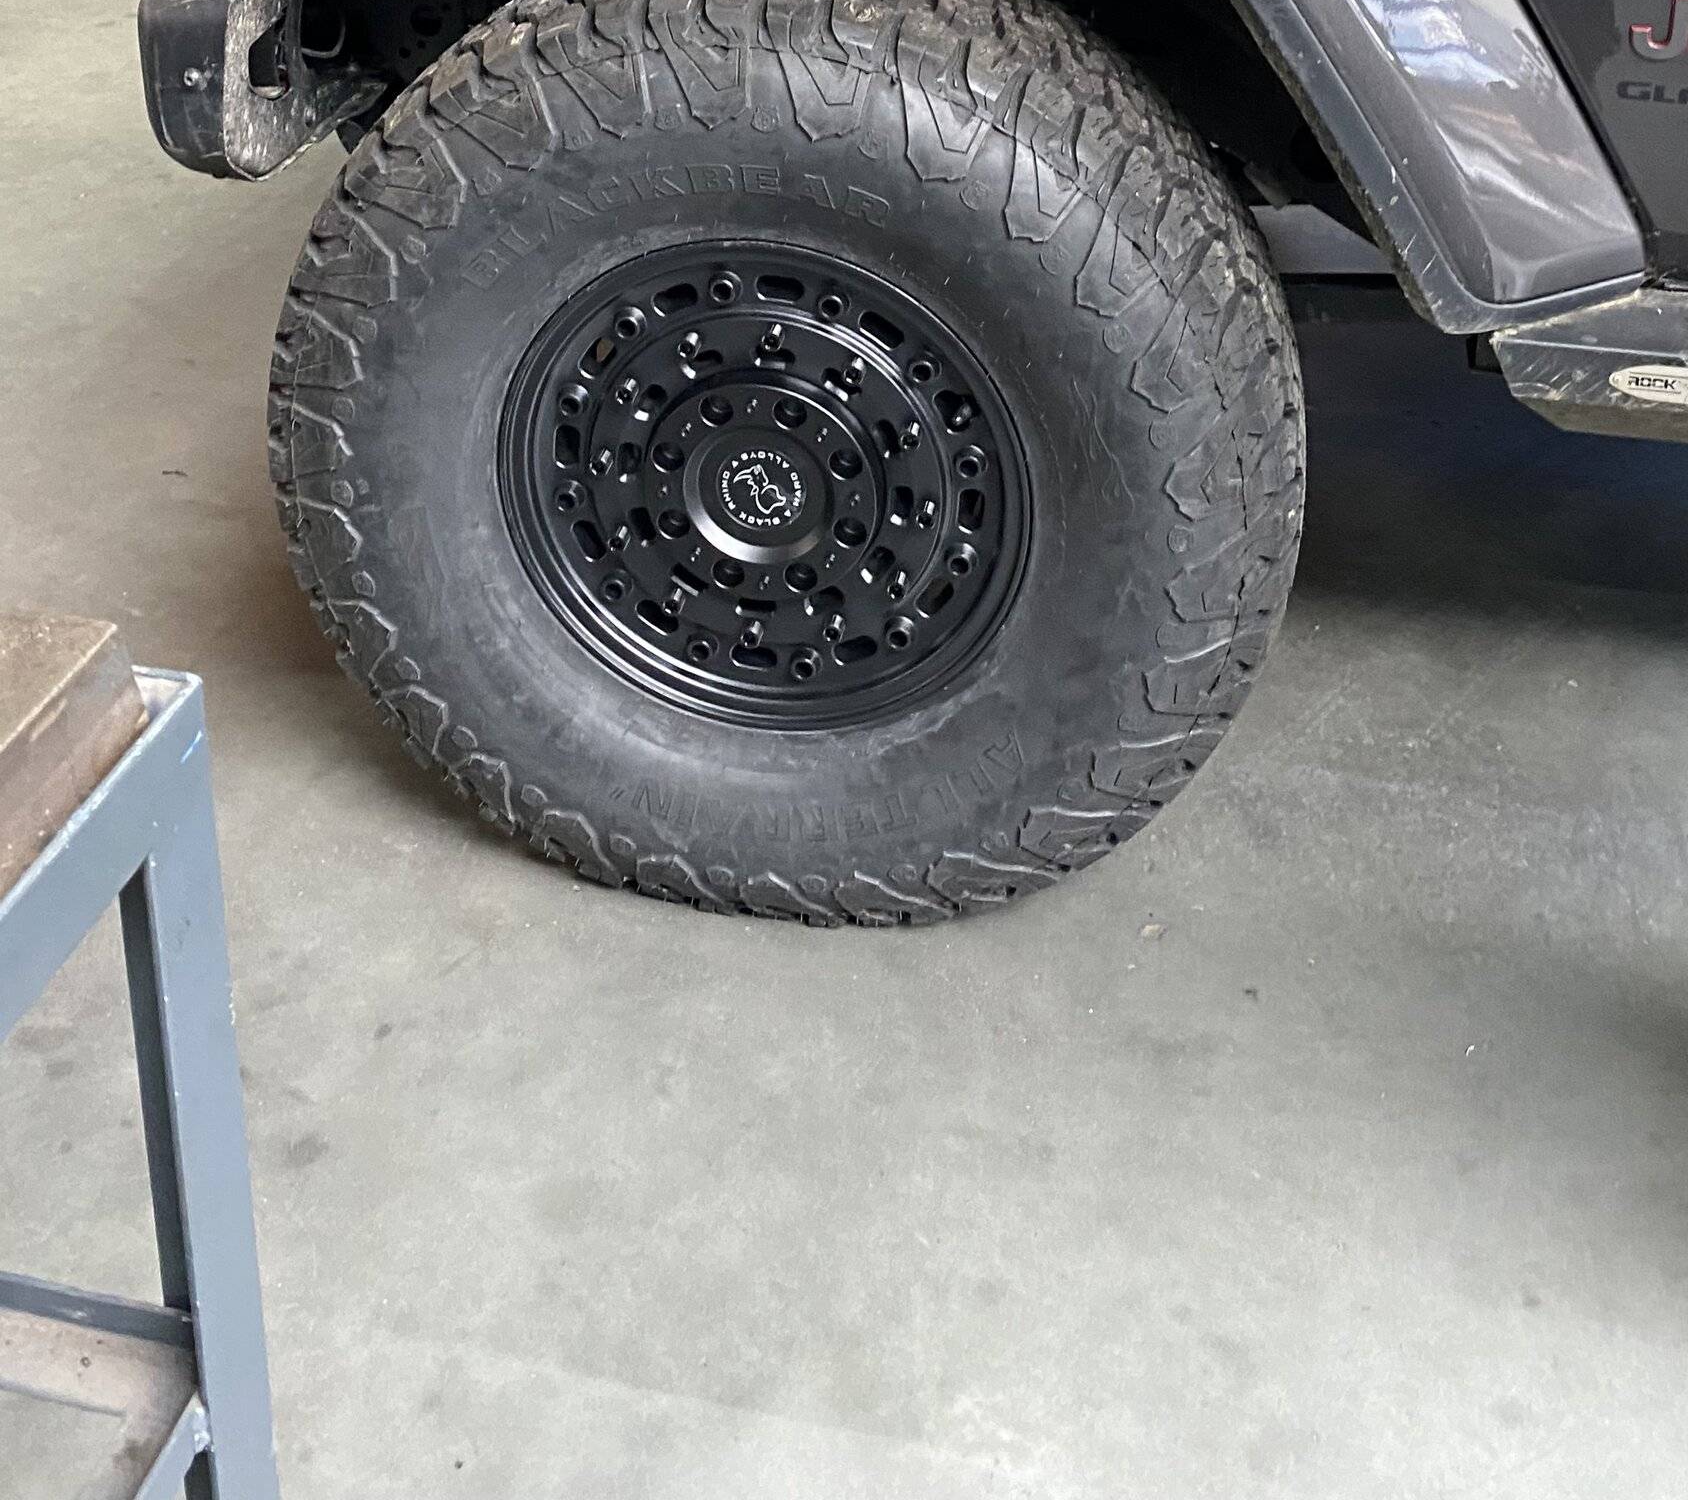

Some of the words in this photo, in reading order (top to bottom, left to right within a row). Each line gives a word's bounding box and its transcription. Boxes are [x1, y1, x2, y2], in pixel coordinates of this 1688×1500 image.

[740, 450, 790, 469] ALLOYS
[721, 470, 736, 511] RHINO
[790, 471, 802, 507] HARD
[739, 511, 781, 527] BLACK
